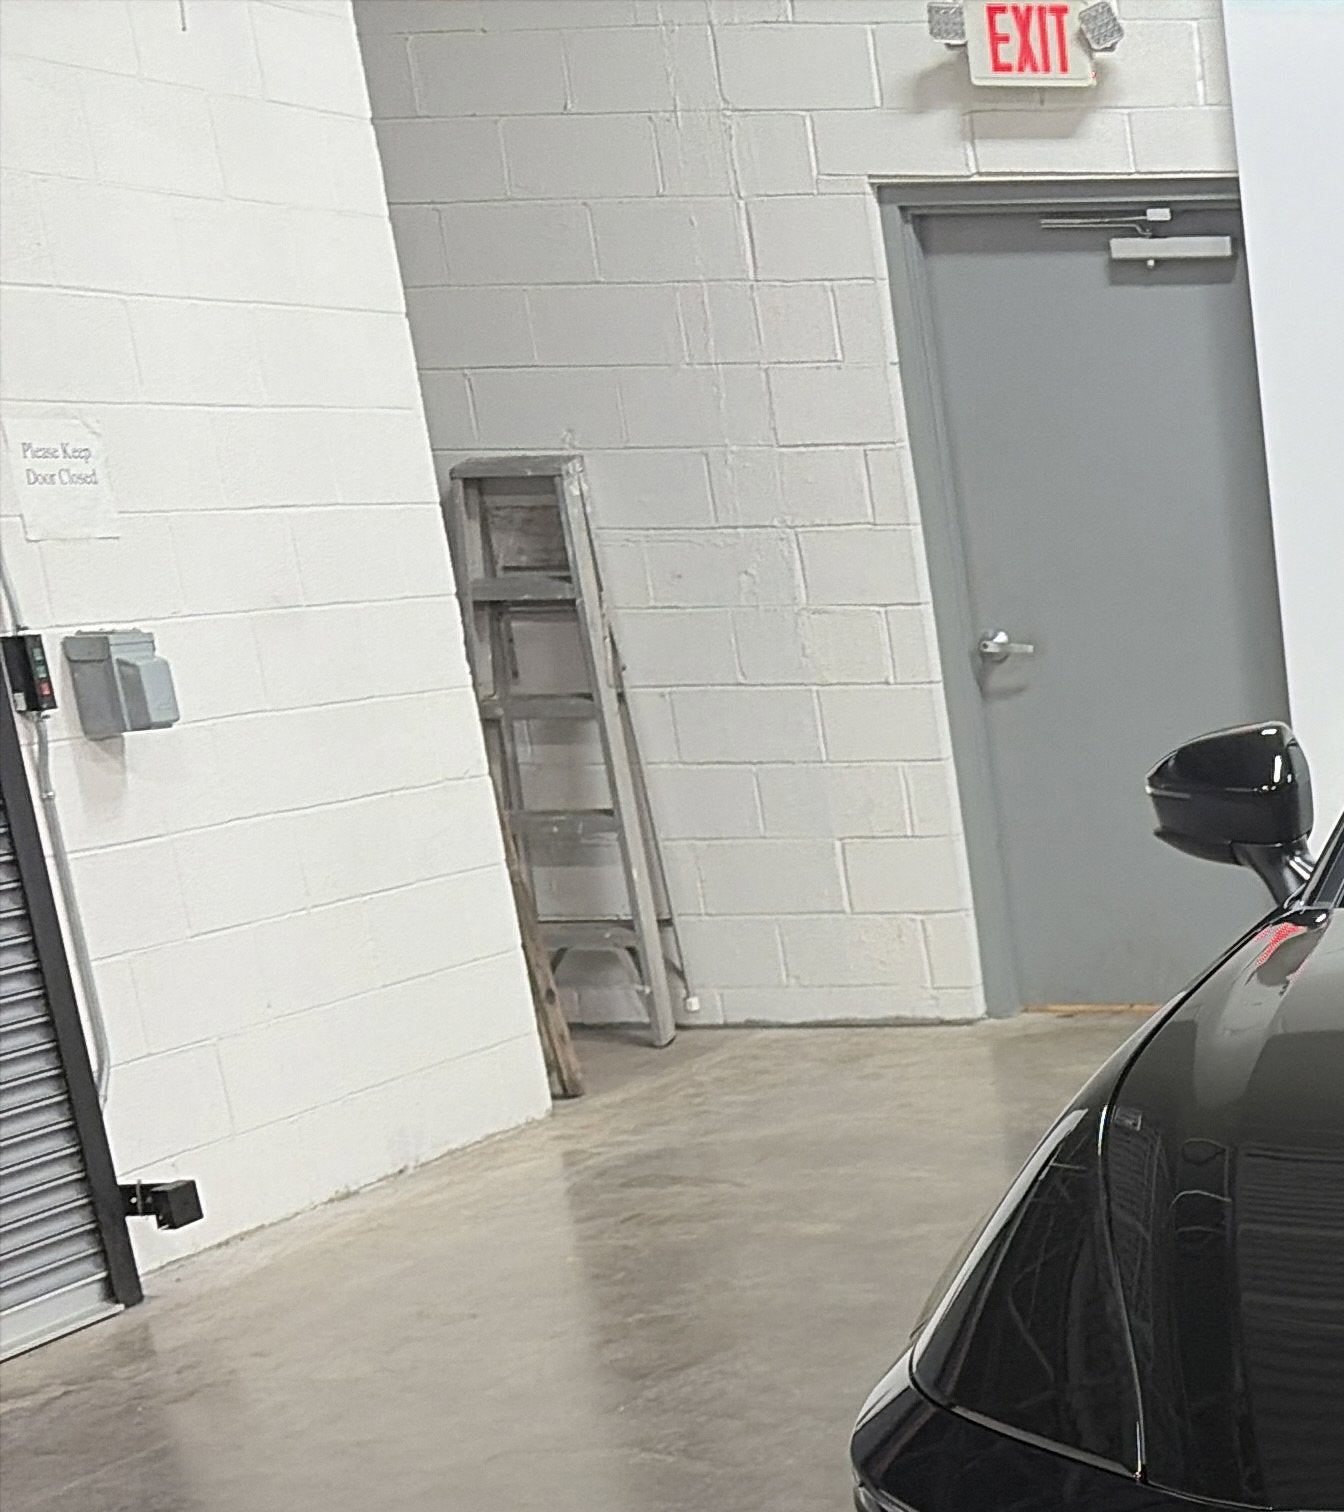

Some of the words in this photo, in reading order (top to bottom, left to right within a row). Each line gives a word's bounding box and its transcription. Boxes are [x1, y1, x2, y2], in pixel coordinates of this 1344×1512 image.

[986, 4, 1069, 74] EXIT
[61, 442, 91, 464] Keep
[25, 468, 56, 485] Door
[58, 468, 98, 485] Closed
